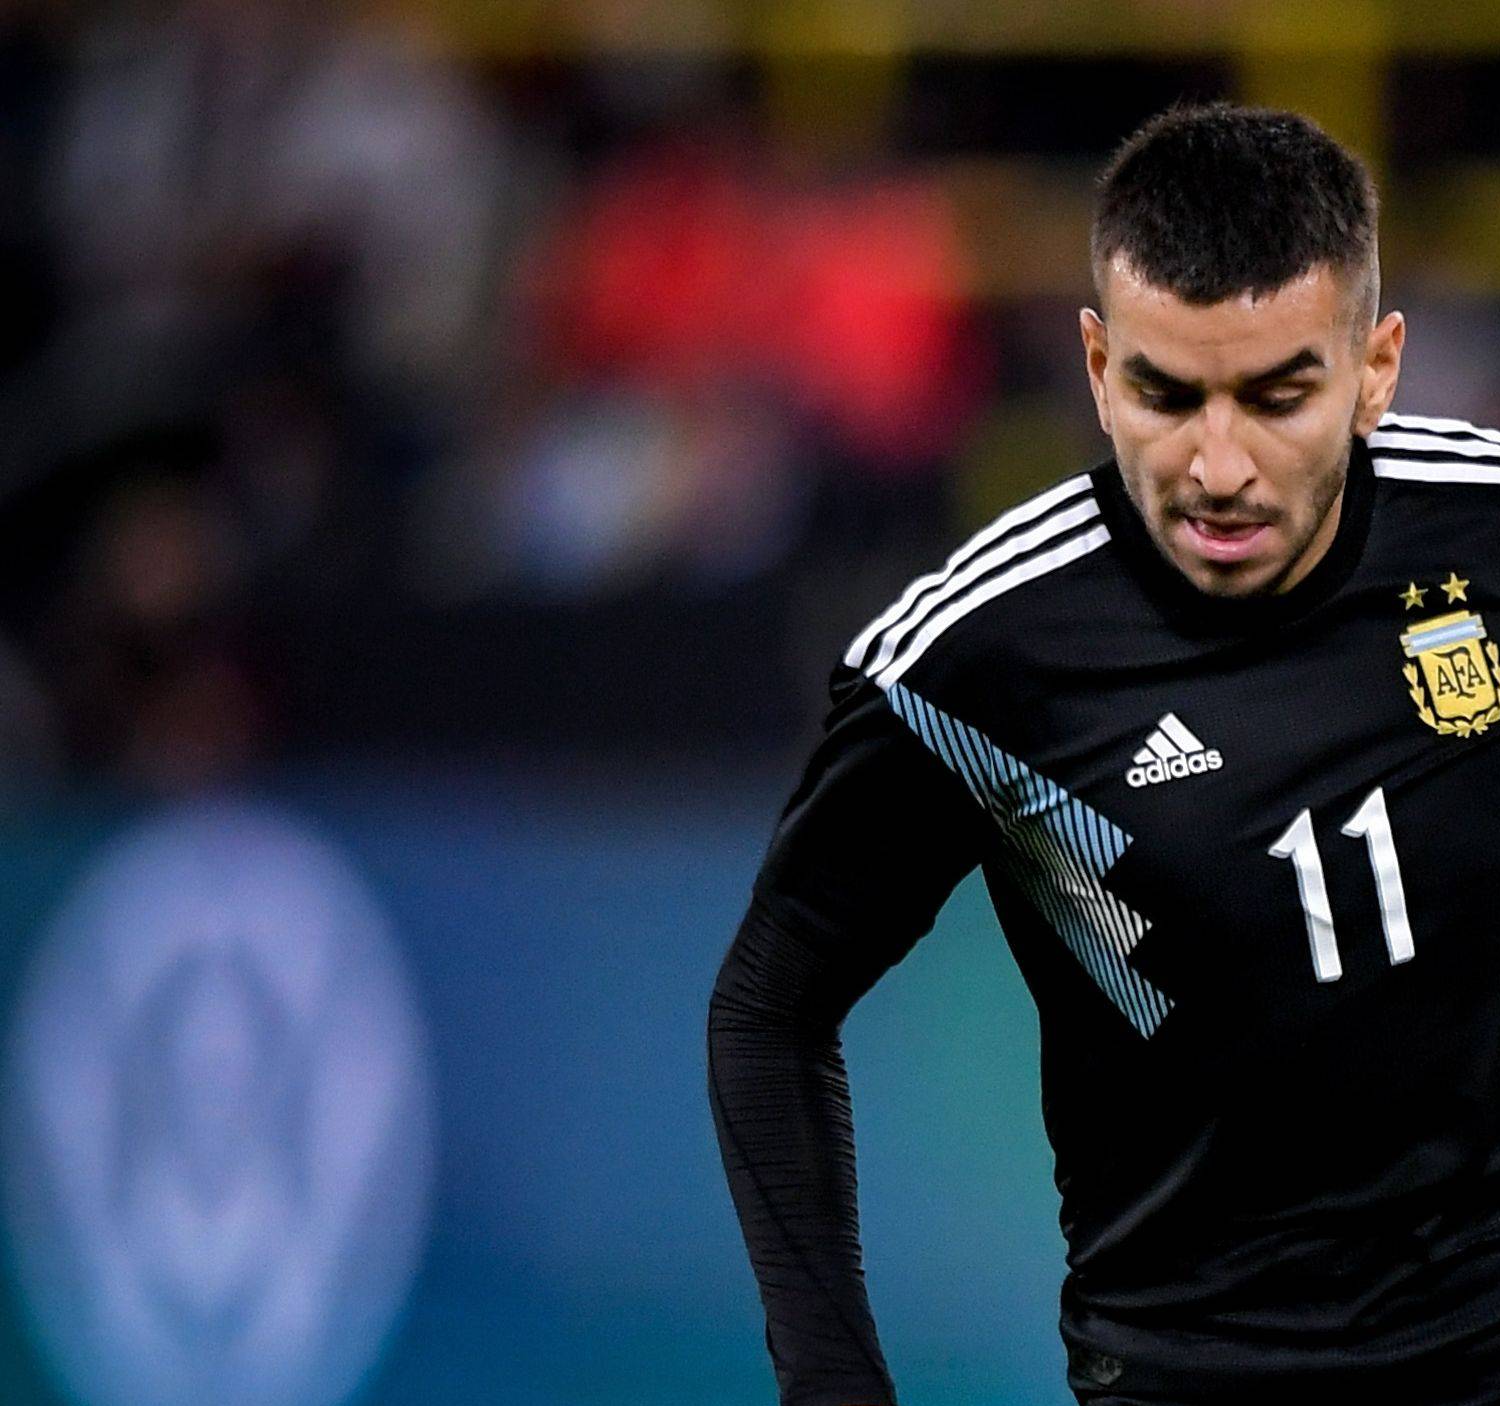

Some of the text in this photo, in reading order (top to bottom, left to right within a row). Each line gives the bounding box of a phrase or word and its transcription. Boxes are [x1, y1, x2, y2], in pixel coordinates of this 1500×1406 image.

[1432, 646, 1487, 699] AFA
[1125, 748, 1225, 789] adidas
[1267, 786, 1415, 983] 11
